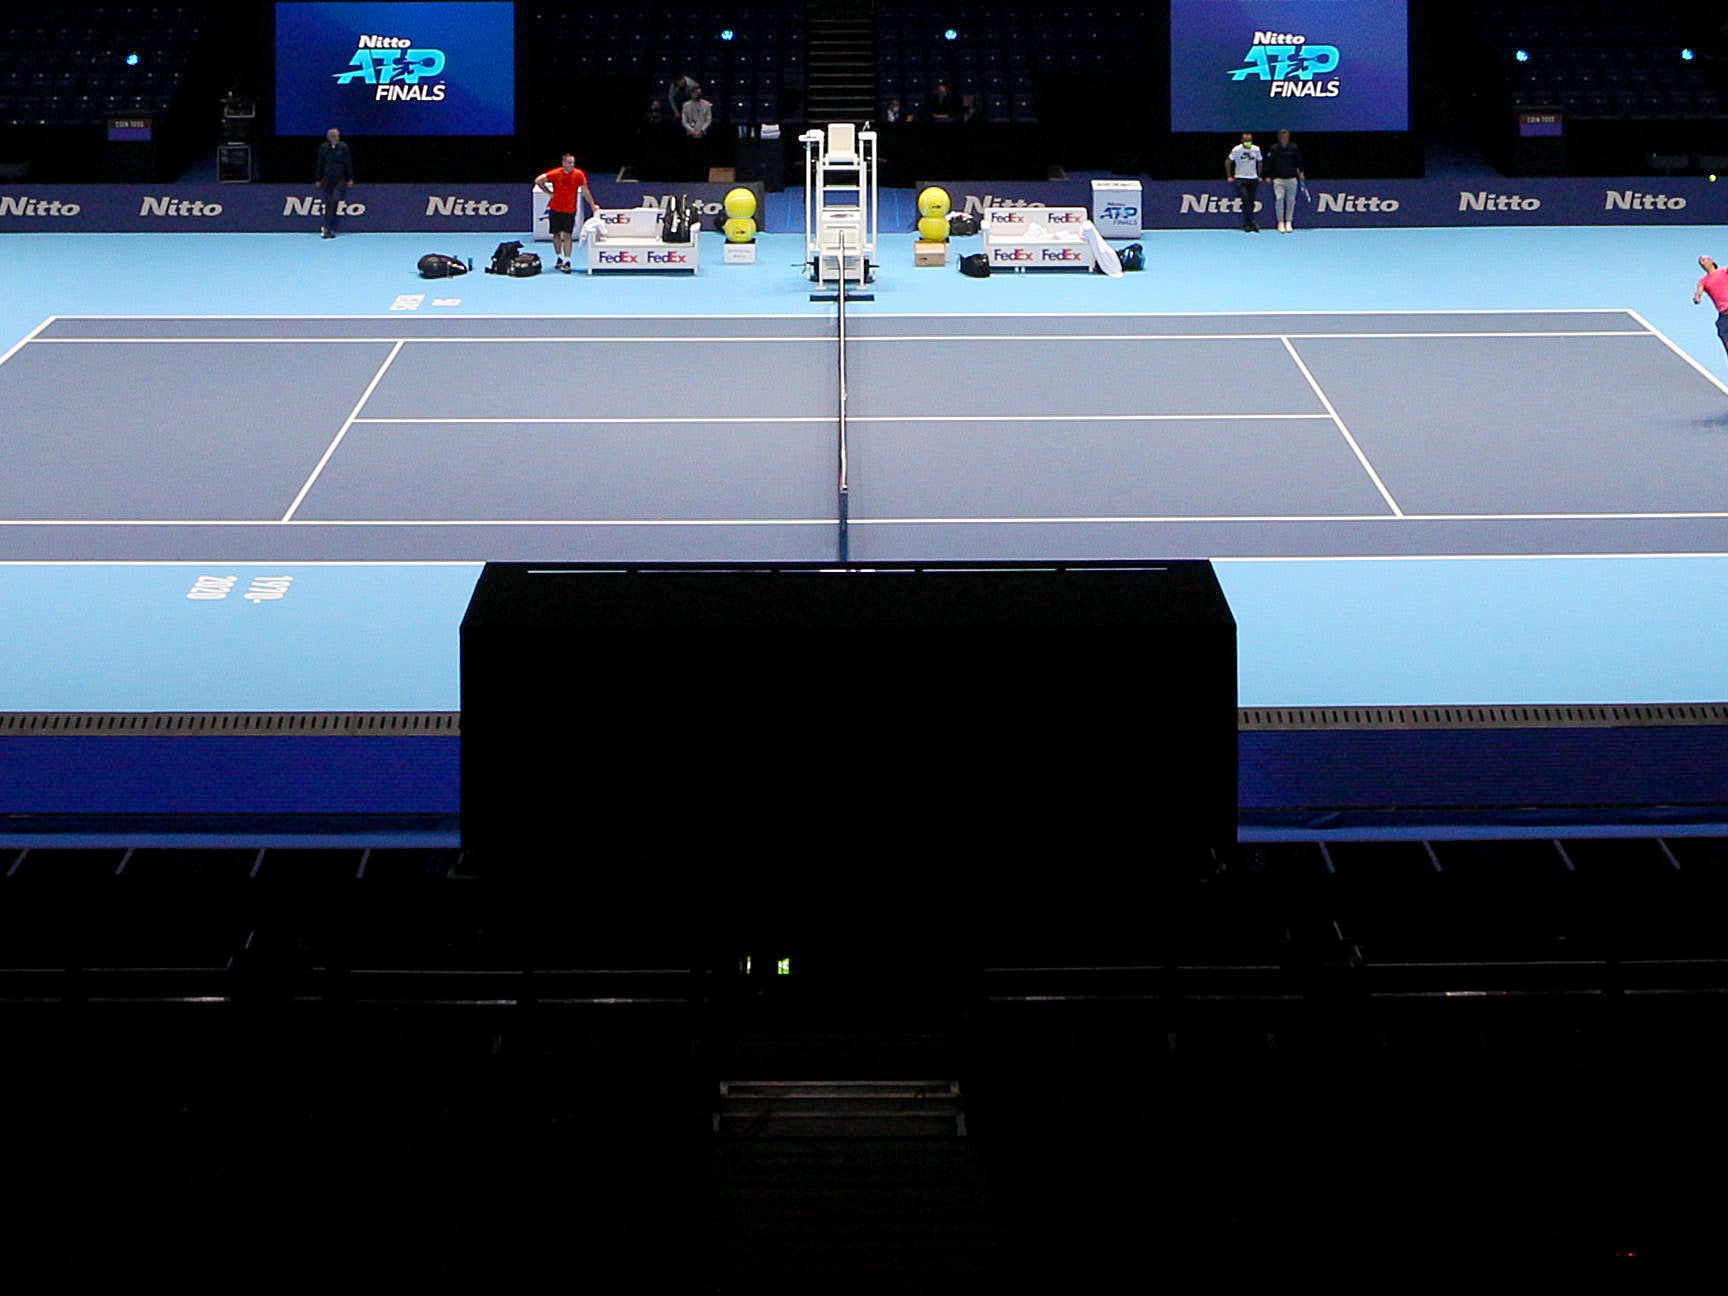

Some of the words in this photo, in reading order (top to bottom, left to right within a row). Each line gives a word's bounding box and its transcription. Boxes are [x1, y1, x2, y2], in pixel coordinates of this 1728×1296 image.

[358, 35, 411, 48] Nitto
[1252, 31, 1306, 45] Nitto
[332, 49, 446, 84] ATP
[1226, 45, 1340, 80] ATP
[375, 85, 446, 101] FINALS
[1270, 81, 1340, 98] FINALS
[139, 196, 223, 216] Nitto
[283, 196, 366, 216] Nito
[425, 196, 509, 216] Nitto
[1317, 192, 1400, 213] Nitto
[1458, 191, 1541, 212] Nitto
[1604, 190, 1687, 210] Nitto
[991, 212, 1024, 223] FedEx
[1048, 213, 1081, 223] FedEx
[599, 251, 638, 263] FedEx
[647, 251, 686, 263] FedEx
[994, 249, 1033, 261] FedEx
[1042, 249, 1081, 261] FedEx
